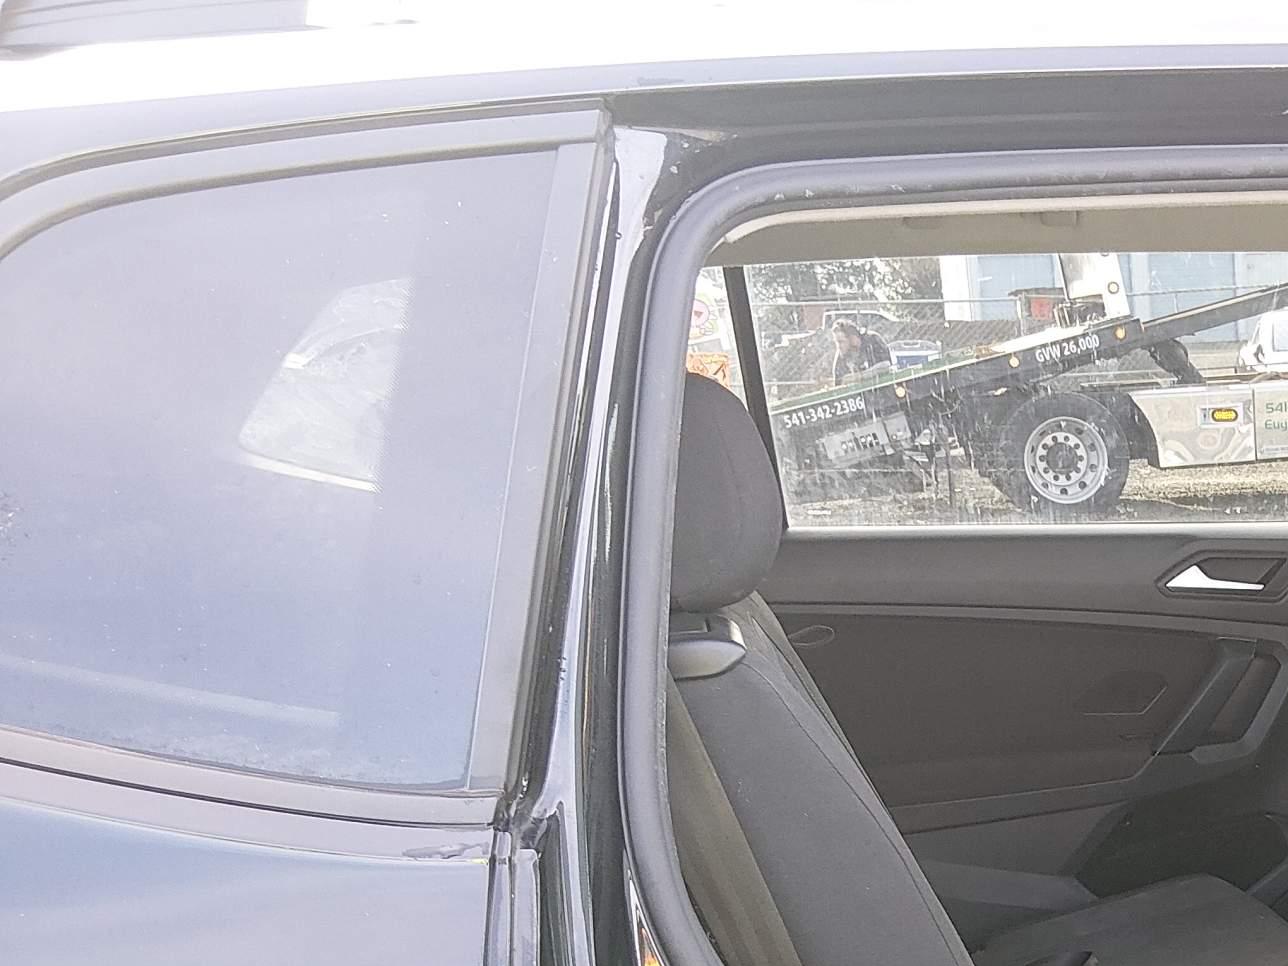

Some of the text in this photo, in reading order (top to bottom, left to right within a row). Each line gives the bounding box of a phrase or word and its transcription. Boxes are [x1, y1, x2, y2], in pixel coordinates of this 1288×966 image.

[1036, 334, 1100, 363] GVW 26,000
[782, 397, 864, 429] 541-342-2386
